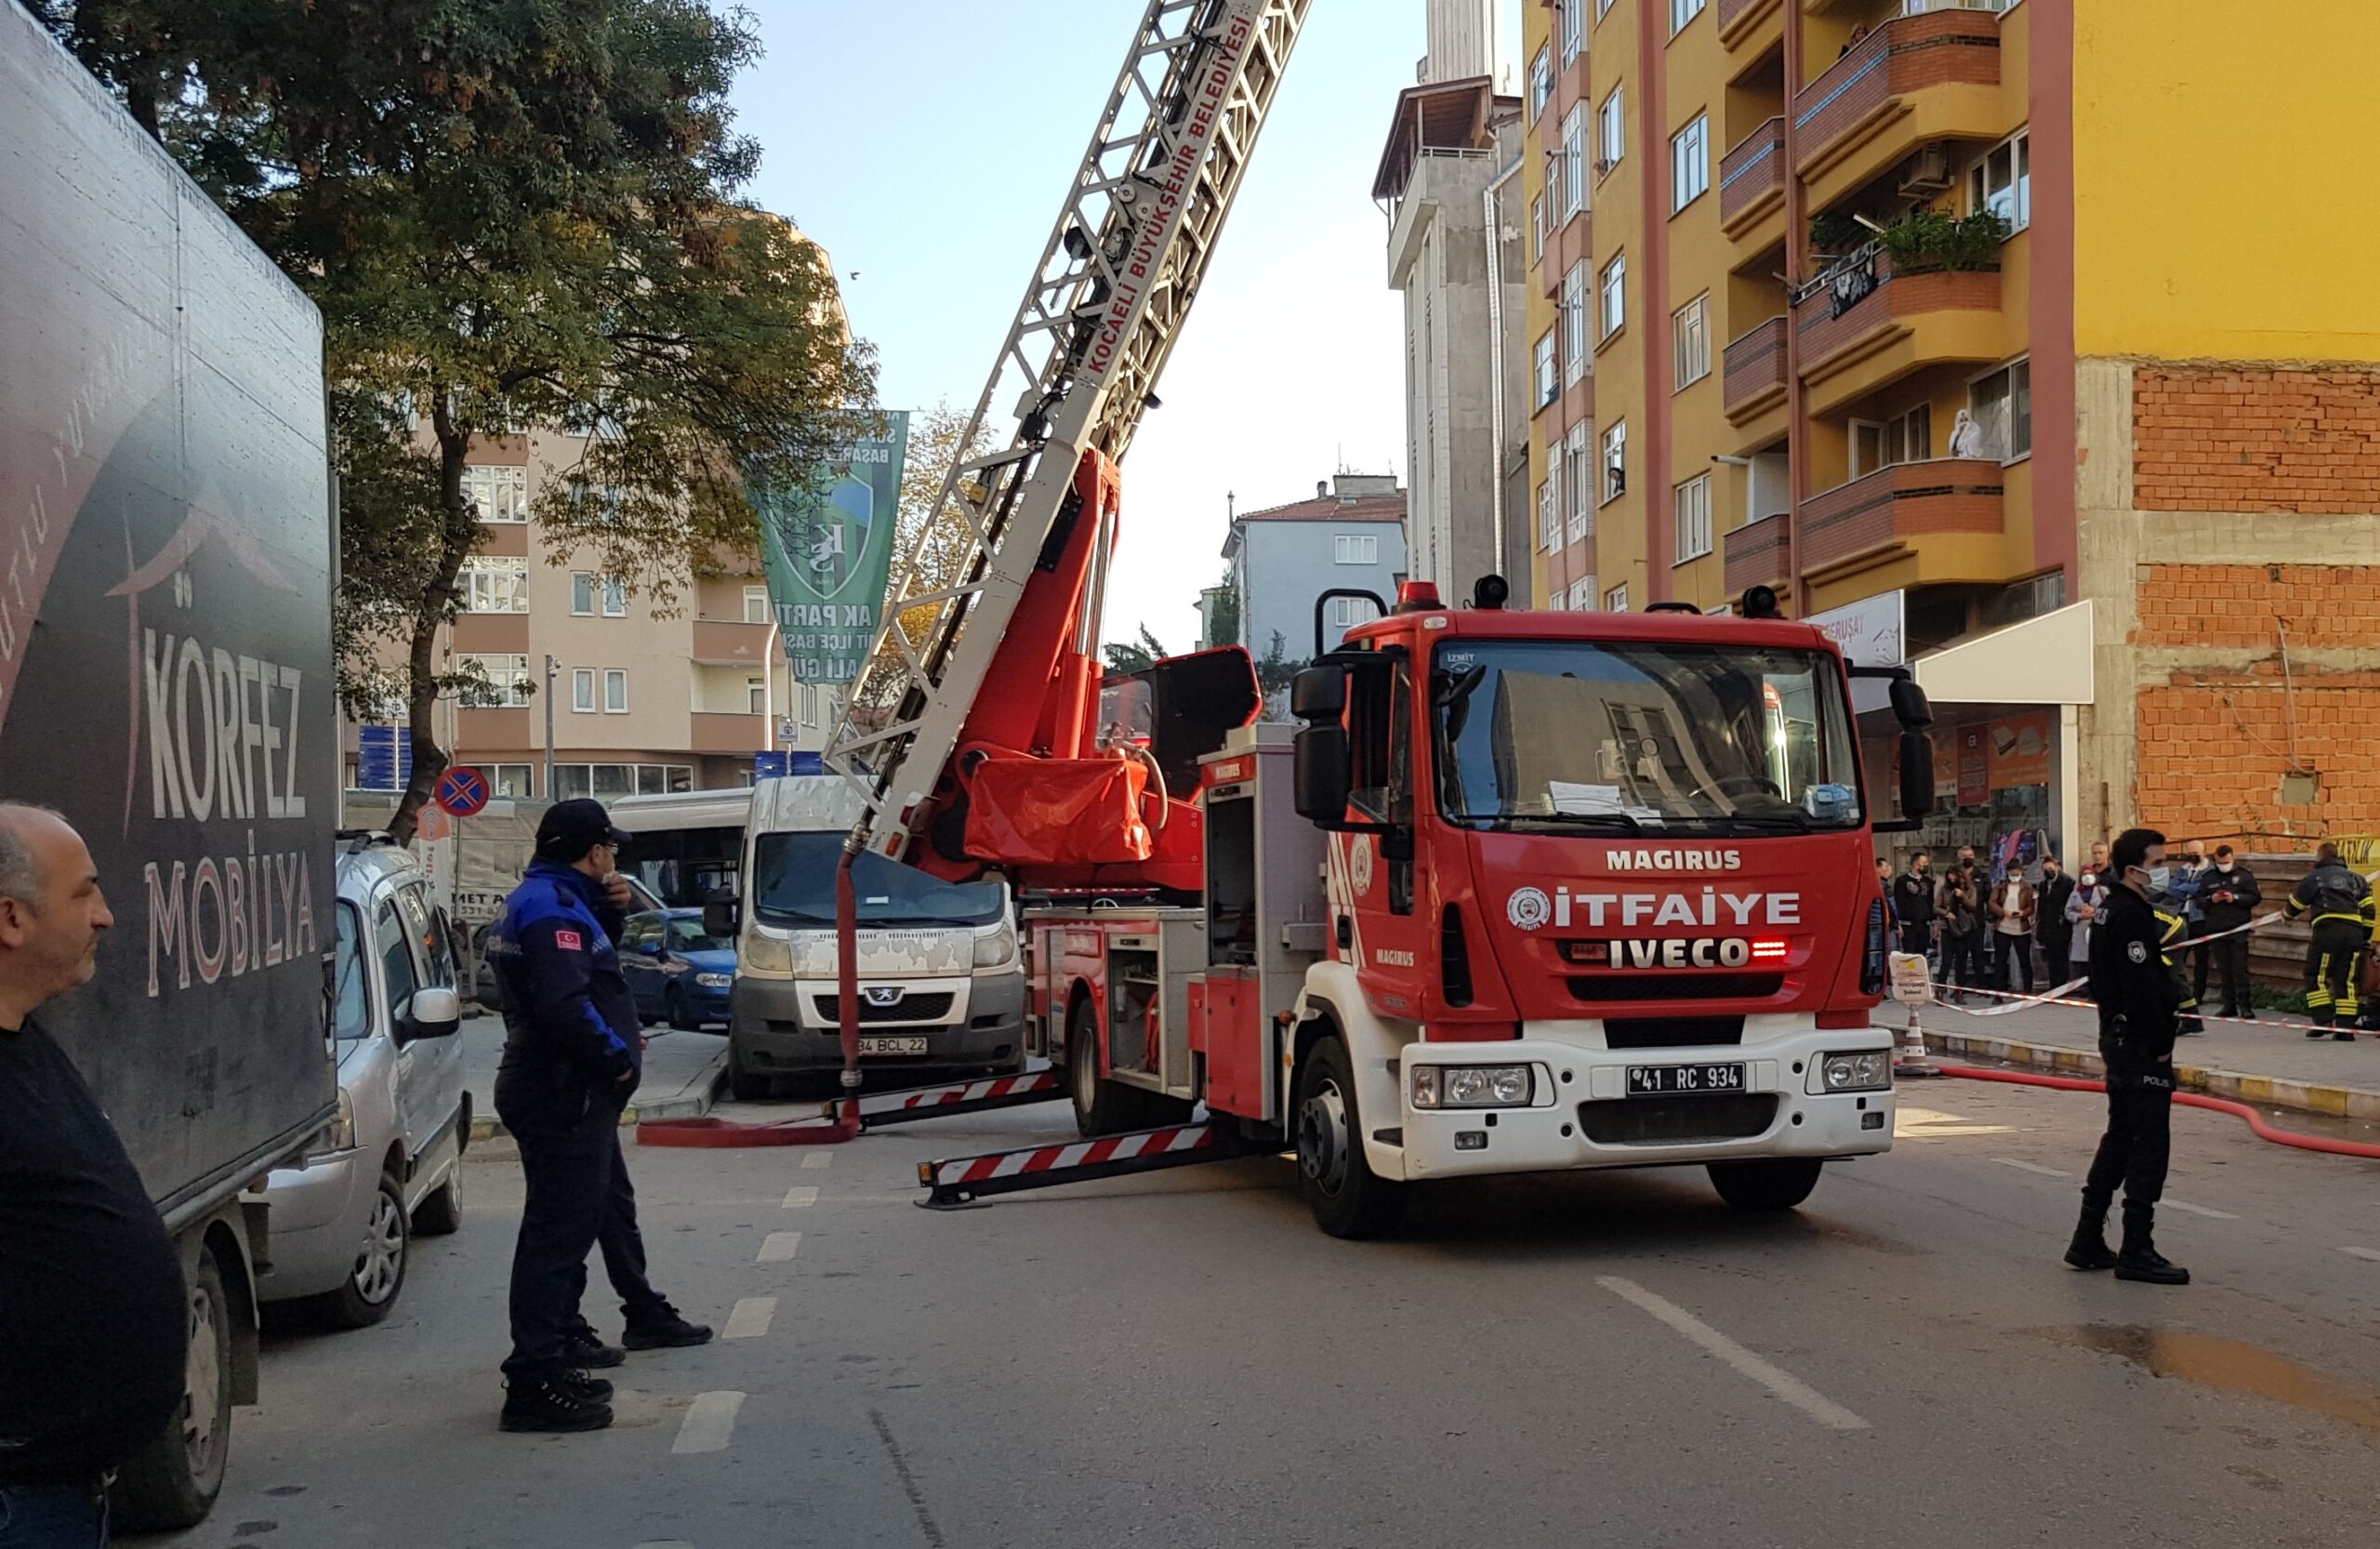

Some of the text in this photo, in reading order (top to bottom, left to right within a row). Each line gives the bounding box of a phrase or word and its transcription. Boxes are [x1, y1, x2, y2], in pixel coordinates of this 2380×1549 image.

[1087, 15, 1251, 374] KOCAELİ BÜYÜKŞEHİR BELEDİYESİ
[1447, 652, 1475, 662] İZMİT
[144, 571, 306, 822] KÖRFEZ
[1606, 850, 1741, 871] MAGIRUS
[144, 829, 316, 998] MOBİLYA
[1554, 885, 1801, 928] İTFAİYE
[1376, 948, 1414, 967] MAGIRUS
[1609, 937, 1750, 969] IVECO
[877, 1039, 905, 1052] BCL
[908, 1039, 925, 1051] 22
[1642, 1066, 1739, 1091] 41 RC 934
